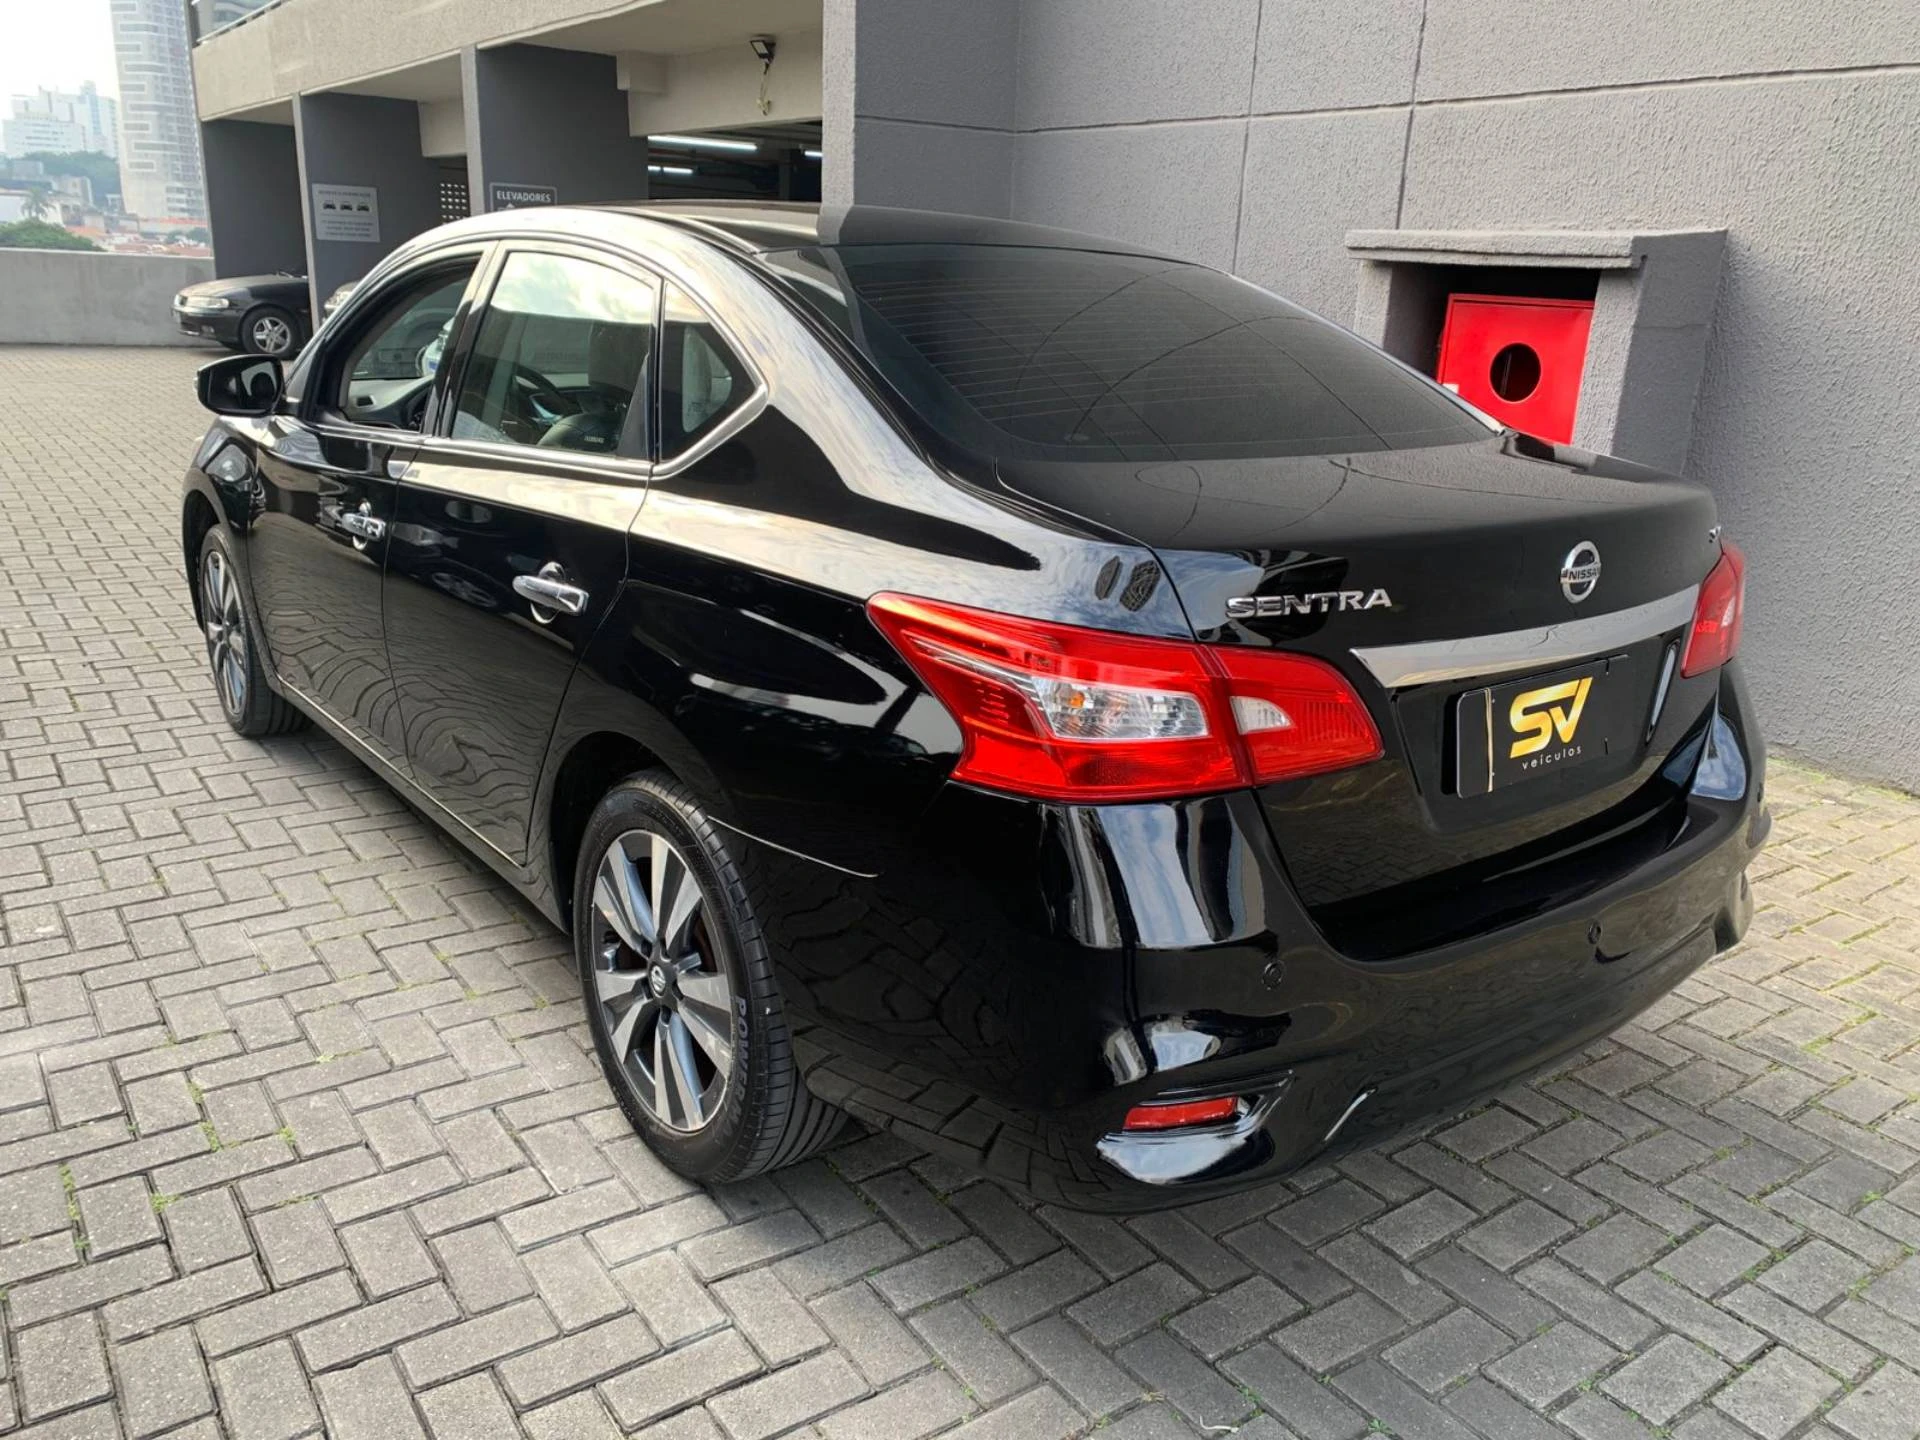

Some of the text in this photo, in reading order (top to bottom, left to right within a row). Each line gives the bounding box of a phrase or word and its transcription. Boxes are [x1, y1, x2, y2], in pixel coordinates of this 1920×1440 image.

[496, 190, 551, 203] ELEVADORES
[1226, 588, 1392, 618] SENTRA
[1510, 677, 1593, 758] SV
